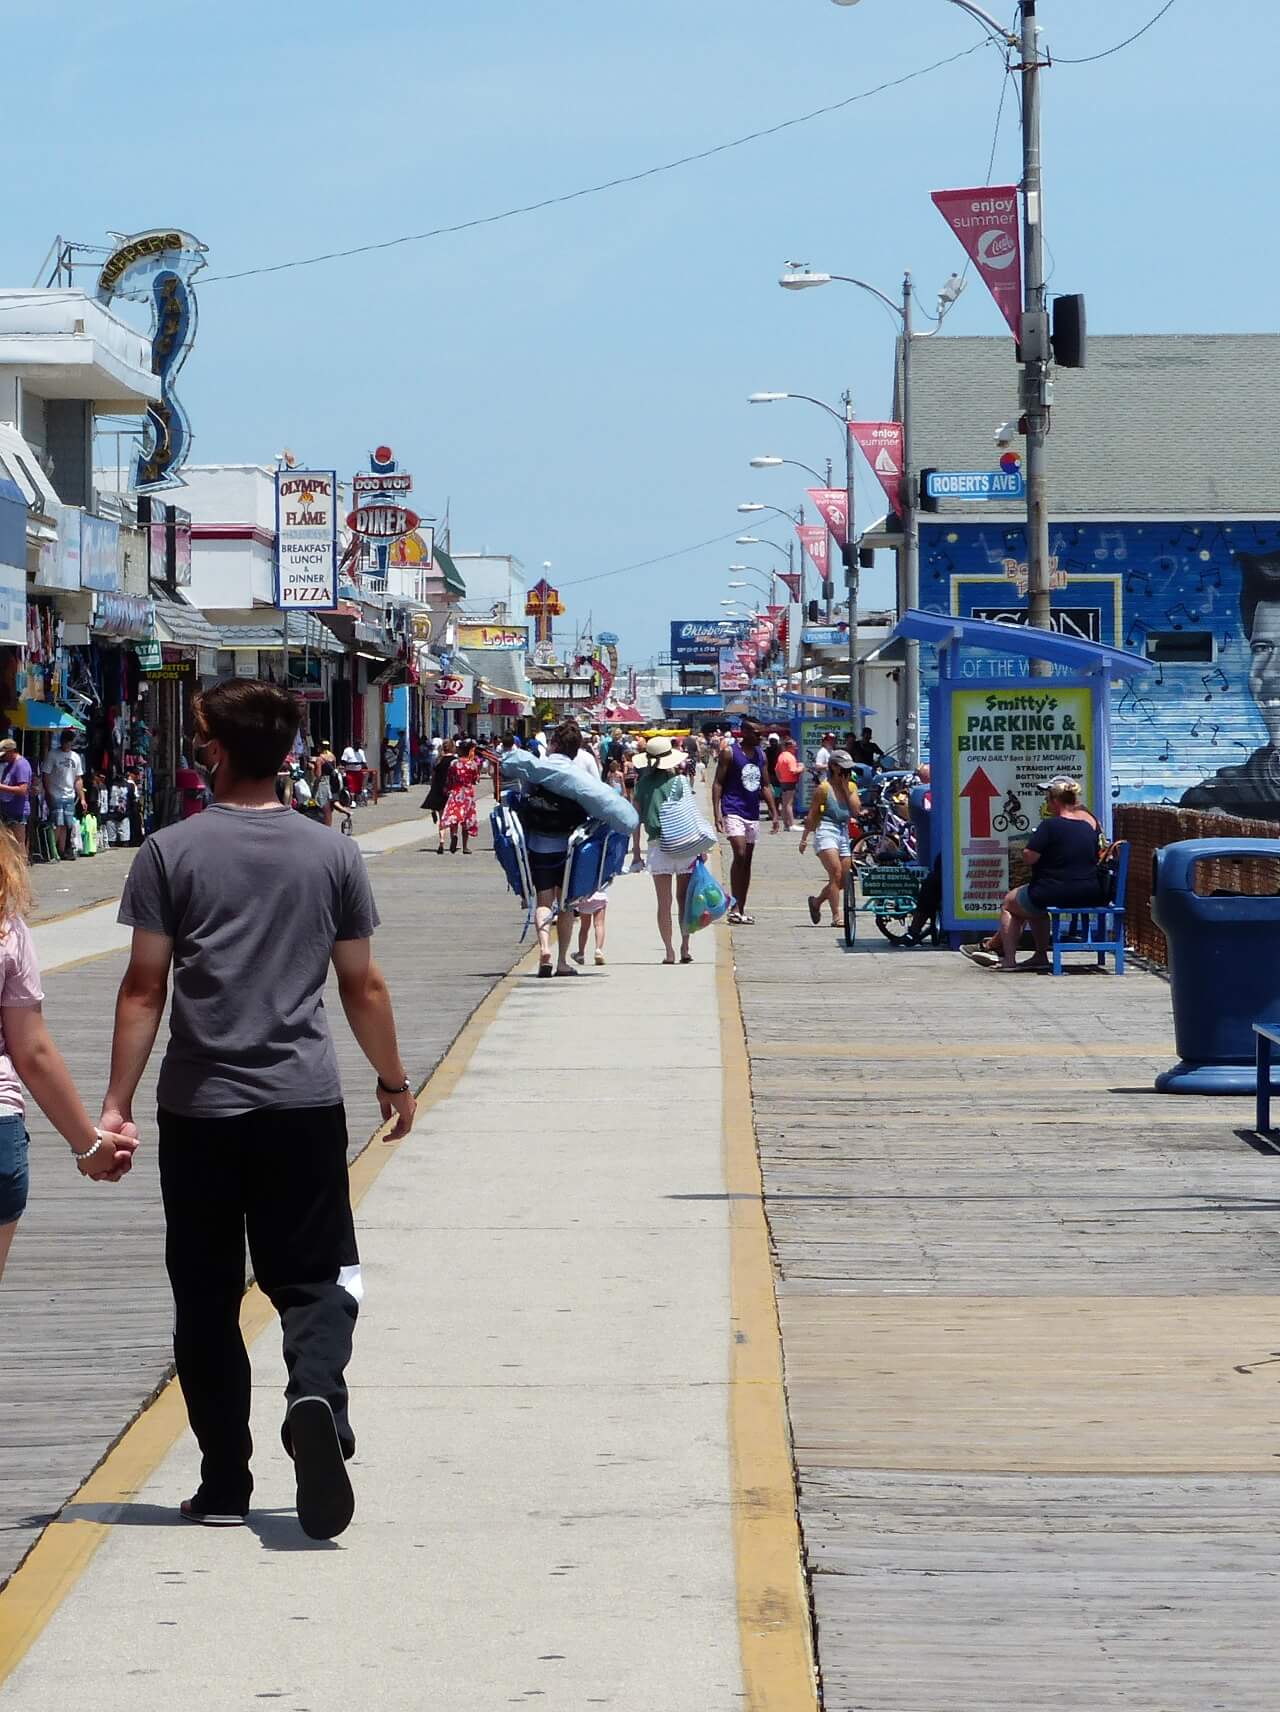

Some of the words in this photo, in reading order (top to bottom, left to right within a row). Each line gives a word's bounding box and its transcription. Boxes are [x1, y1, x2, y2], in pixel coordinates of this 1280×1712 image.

[971, 199, 1013, 214] enjoy
[953, 214, 1015, 228] summer
[871, 429, 899, 439] enjoy
[860, 437, 899, 447] summer
[280, 480, 331, 497] OLYMPIC
[382, 479, 409, 490] WOP
[933, 475, 990, 493] ROBERTS
[992, 474, 1017, 492] AVE
[286, 511, 327, 526] FLAME
[356, 510, 408, 534] DINER
[282, 543, 331, 553] BREAKFAST
[290, 555, 323, 564] LUNCH
[289, 574, 324, 583] DINNER
[283, 587, 331, 601] PIZZA
[986, 658, 1015, 678] THE
[985, 694, 1058, 714] Smitty's
[967, 715, 1054, 732] PARKING
[1062, 714, 1076, 731] &
[958, 735, 1004, 752] BIKE
[1011, 733, 1086, 751] RENTAL
[988, 754, 1008, 762] DAILY
[1042, 754, 1076, 762] MIDNIGHT
